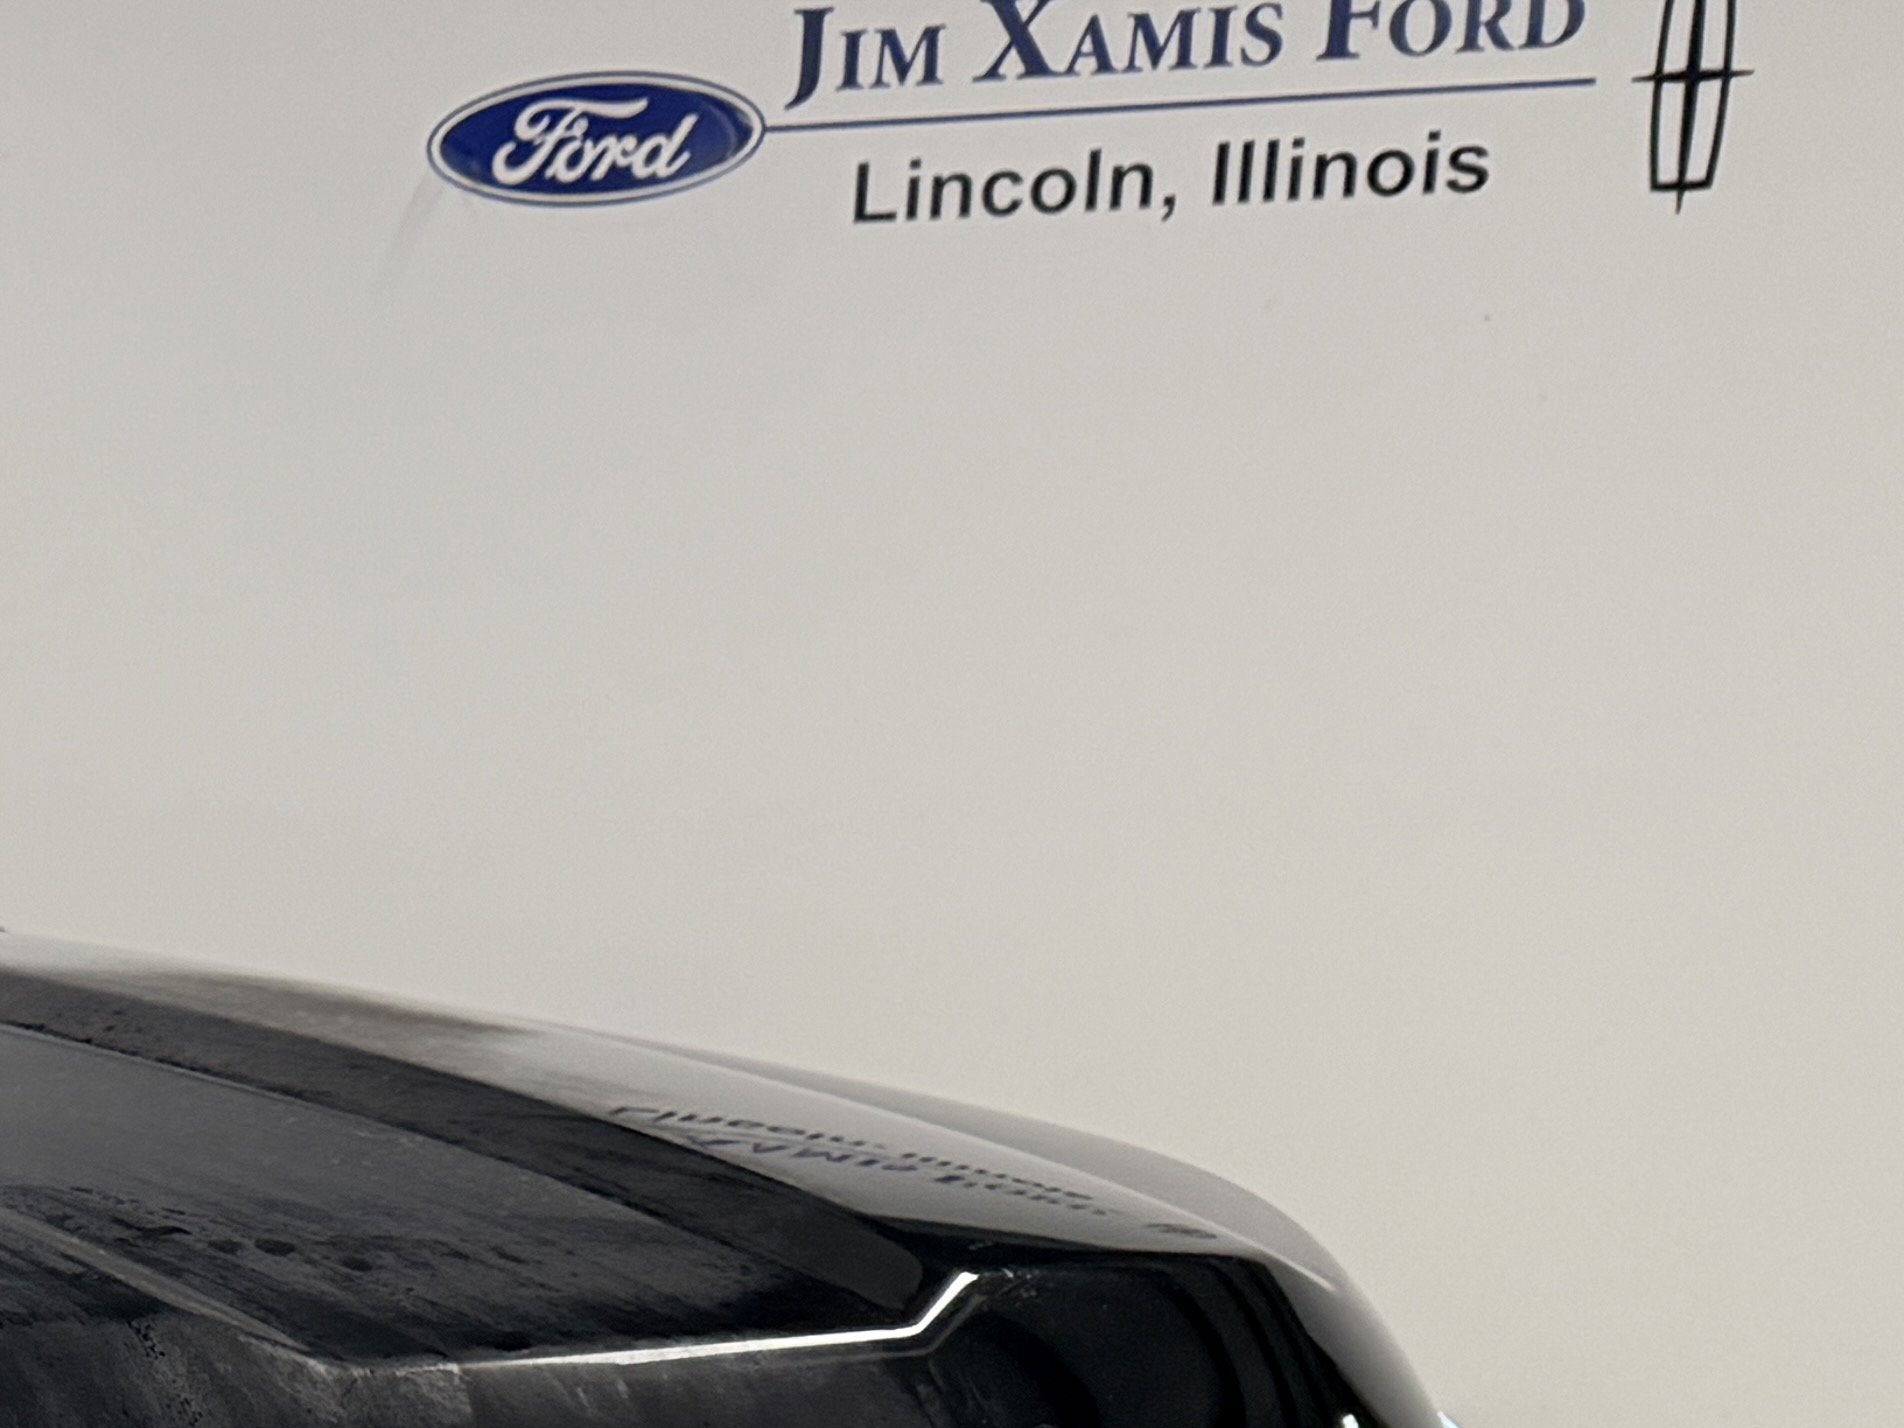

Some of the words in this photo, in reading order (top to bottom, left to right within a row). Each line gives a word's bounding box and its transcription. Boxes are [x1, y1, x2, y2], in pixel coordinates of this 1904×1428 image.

[785, 6, 946, 110] JIM
[972, 0, 1283, 83] XAMIS
[1317, 0, 1586, 61] FORD
[492, 98, 698, 186] Ford
[853, 149, 1177, 224] Lincoln,
[1212, 130, 1490, 206] Illinois
